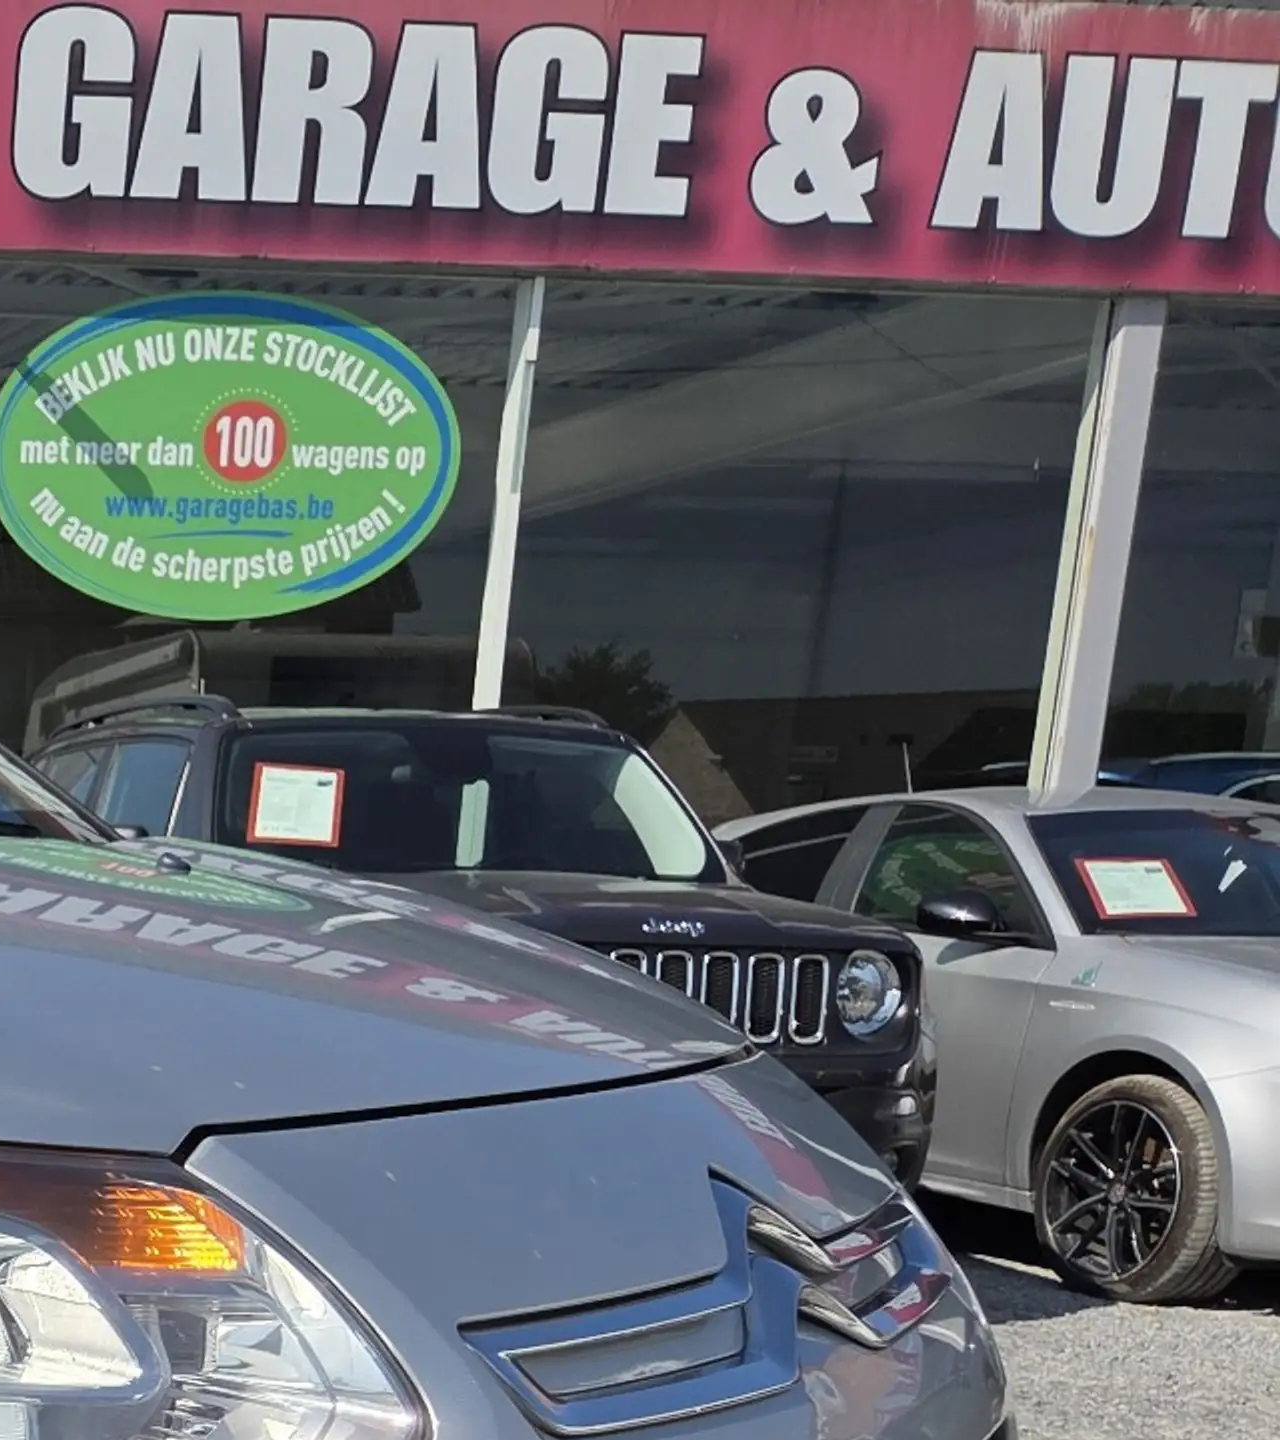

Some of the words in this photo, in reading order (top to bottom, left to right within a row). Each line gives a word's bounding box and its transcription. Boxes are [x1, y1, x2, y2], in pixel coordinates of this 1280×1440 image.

[11, 3, 706, 217] GARAGE
[748, 66, 883, 226] &
[927, 46, 1280, 239] AUT
[34, 344, 133, 426] BEKIJK
[134, 332, 175, 371] NU
[184, 328, 257, 362] ONZE
[262, 331, 417, 427] STOCKLIJST
[20, 437, 69, 464] met
[75, 443, 138, 466] meer
[147, 437, 193, 467] dan
[215, 415, 275, 468] 100
[292, 444, 389, 475] wagens
[395, 446, 425, 477] op
[30, 487, 64, 527] nu
[59, 514, 108, 559] aan
[111, 539, 145, 572] de
[151, 546, 294, 589] scherpste
[301, 511, 393, 577] prijzen
[105, 493, 333, 524] www.garagebas.be
